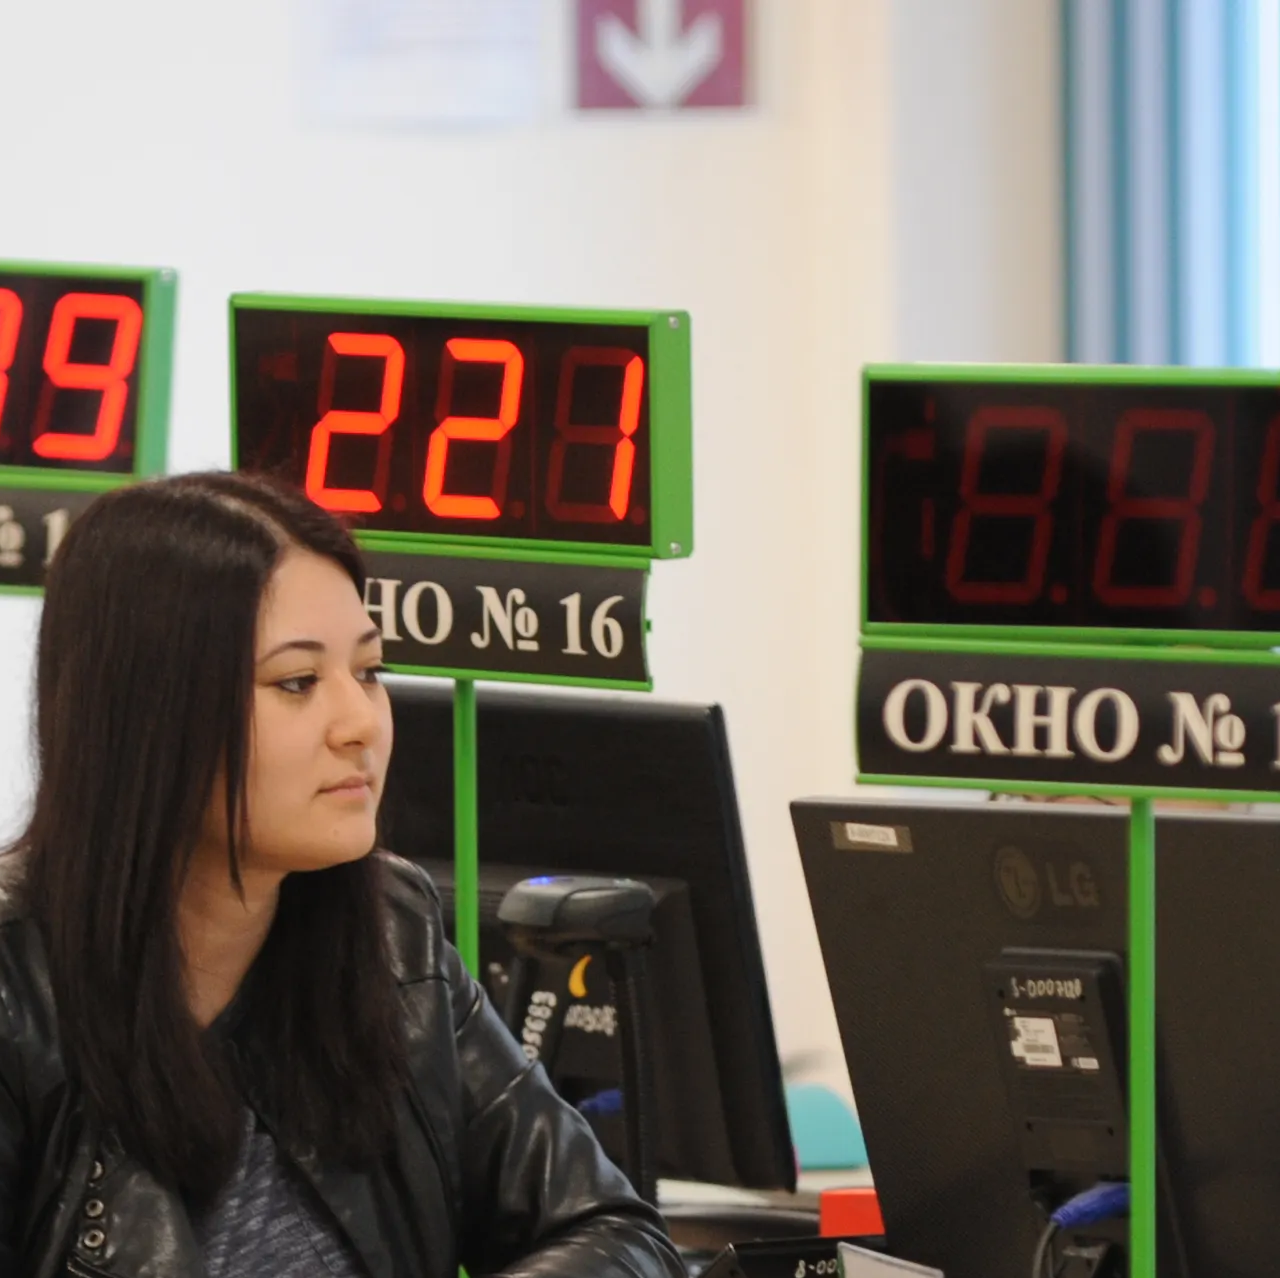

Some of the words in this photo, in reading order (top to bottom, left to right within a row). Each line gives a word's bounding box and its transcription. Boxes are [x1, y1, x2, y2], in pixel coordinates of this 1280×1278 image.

[305, 332, 644, 521] 221
[42, 507, 69, 566] 1
[364, 577, 453, 645] НО
[471, 585, 539, 651] №
[560, 592, 625, 658] 16
[883, 679, 1140, 761] ОКНО
[1157, 692, 1246, 767] №
[1045, 861, 1099, 906] LG
